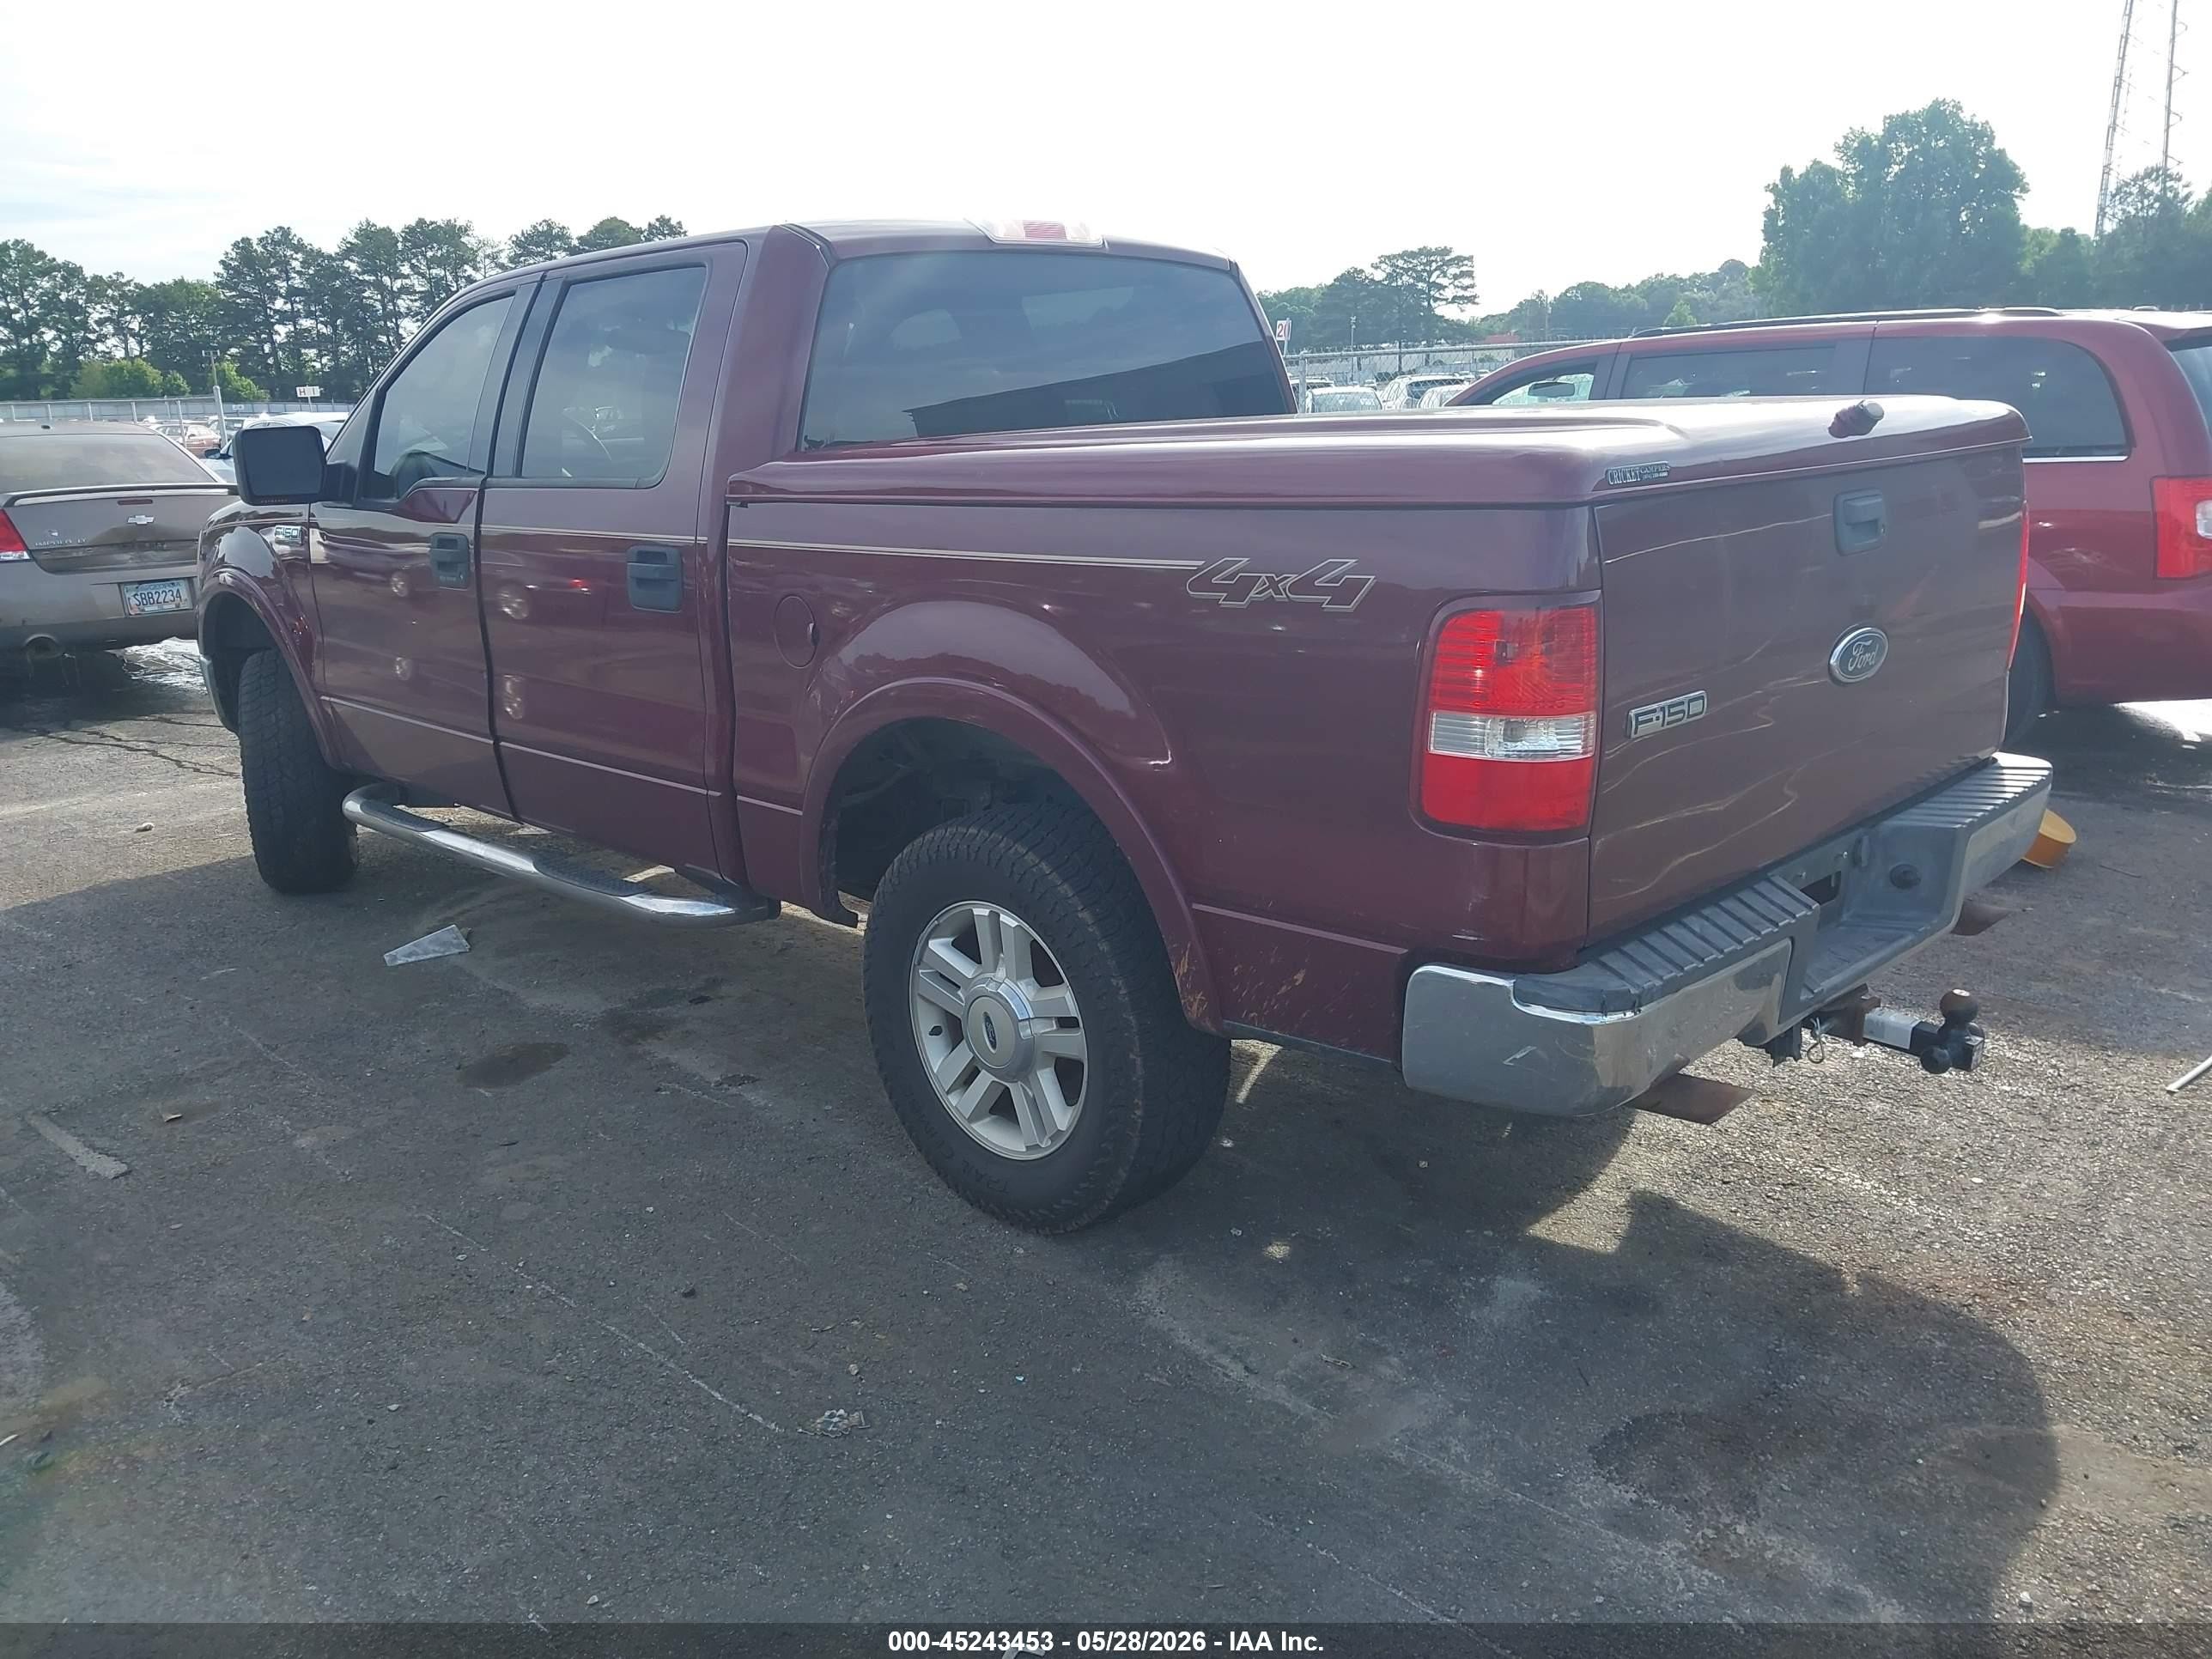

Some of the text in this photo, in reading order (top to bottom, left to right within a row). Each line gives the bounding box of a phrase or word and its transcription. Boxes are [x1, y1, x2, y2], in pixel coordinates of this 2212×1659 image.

[1607, 468, 1641, 485] CRICKET
[1640, 464, 1670, 474] CAMPERS
[132, 587, 183, 606] SBB2234
[1186, 557, 1376, 612] 4x4
[1847, 639, 1880, 672] Ford
